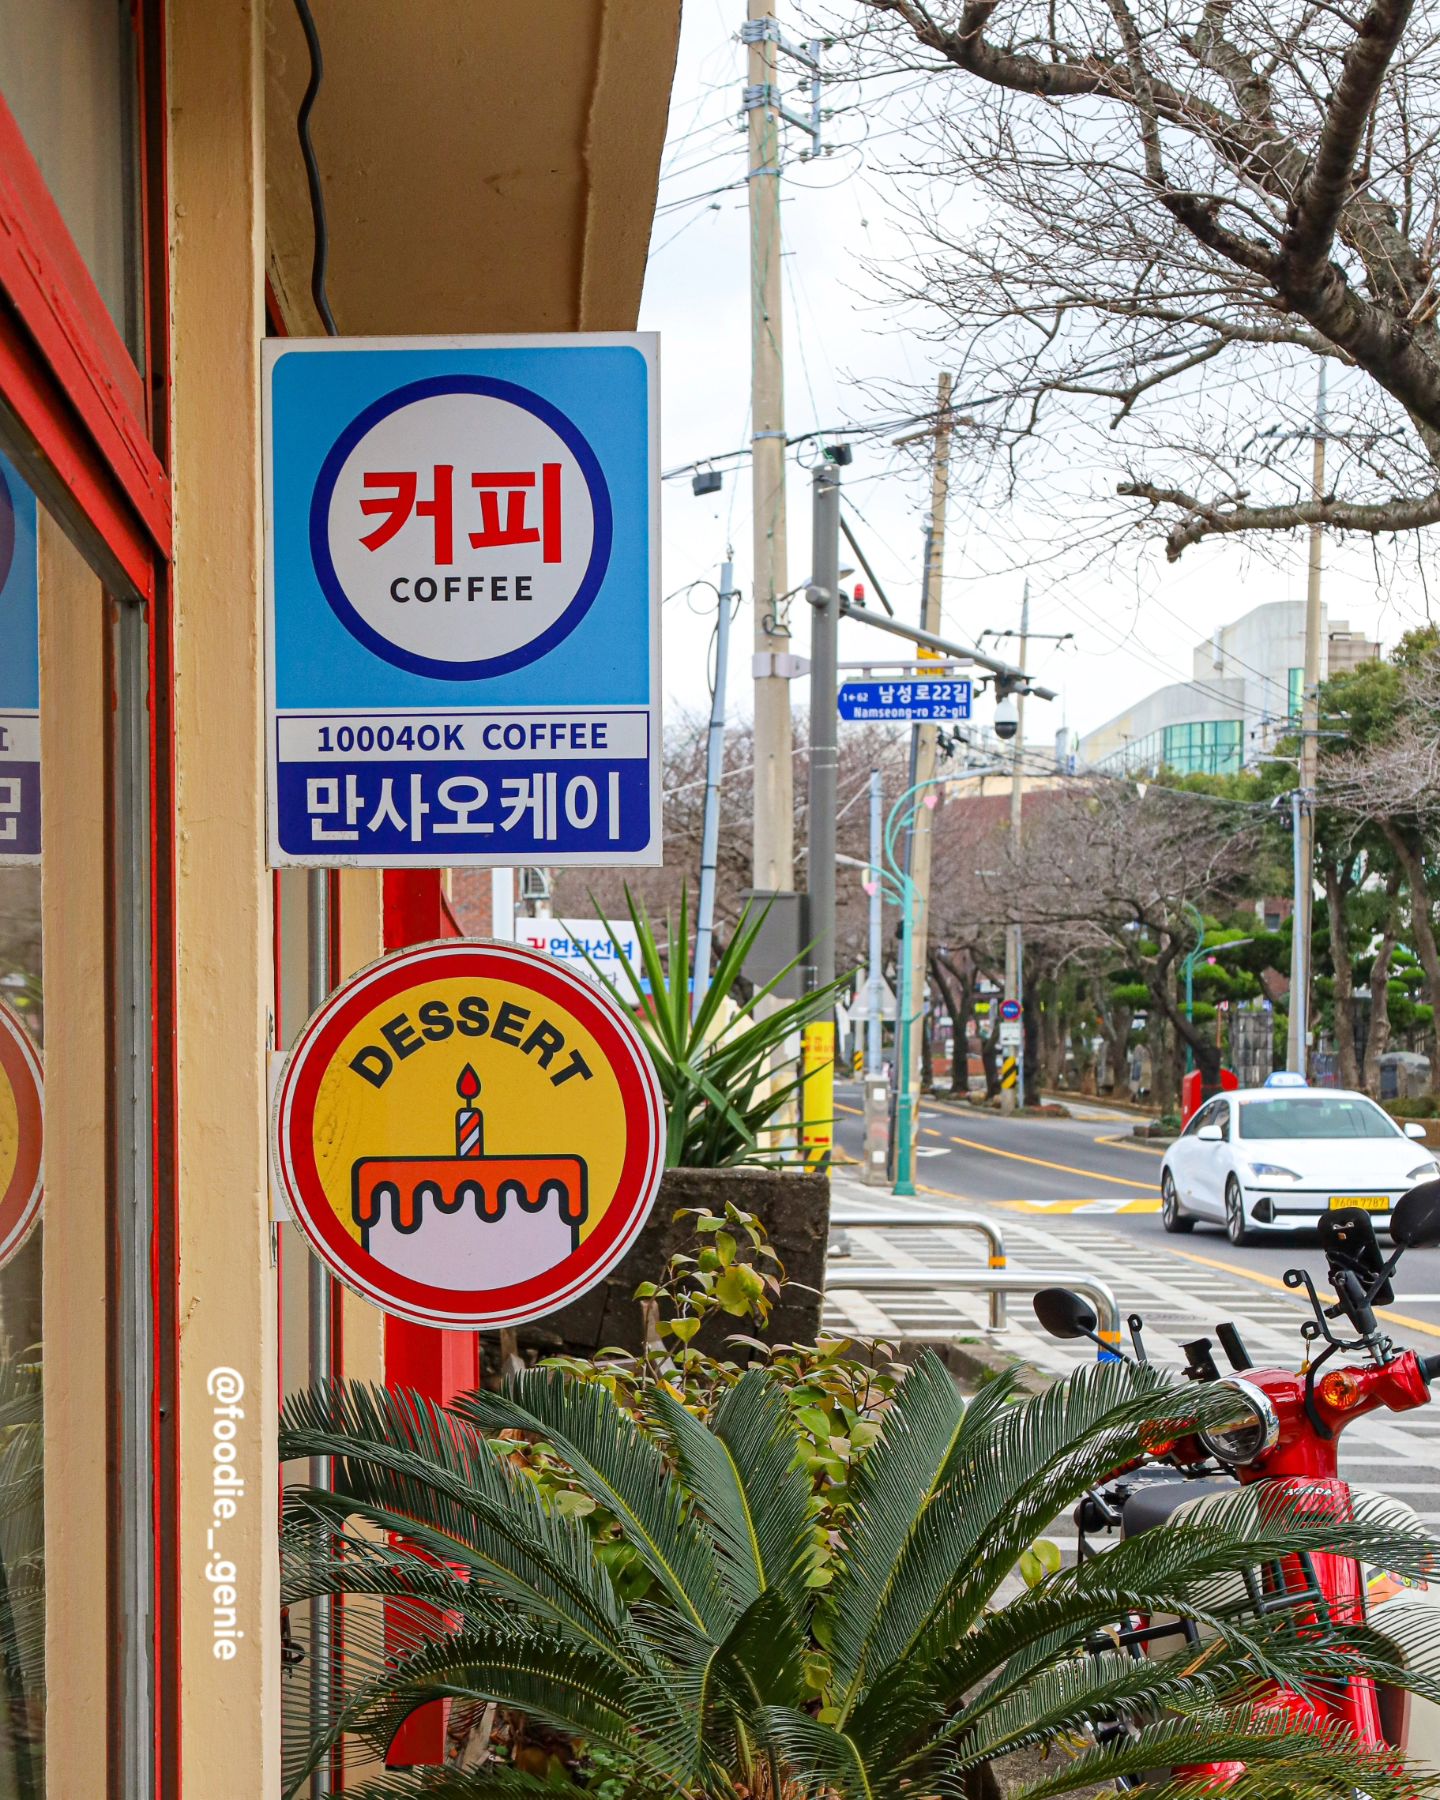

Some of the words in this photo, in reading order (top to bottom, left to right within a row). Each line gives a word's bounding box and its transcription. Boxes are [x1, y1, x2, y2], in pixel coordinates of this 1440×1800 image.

[360, 463, 561, 565] 커피
[390, 576, 532, 603] COFFEE
[878, 684, 968, 704] 남성로22길
[853, 706, 929, 719] Namseong-ro
[932, 705, 967, 719] 22-gil
[317, 724, 465, 752] 10004OK
[482, 723, 608, 750] COFFEE
[306, 771, 620, 841] 만사오케이
[348, 996, 594, 1089] DESSERT
